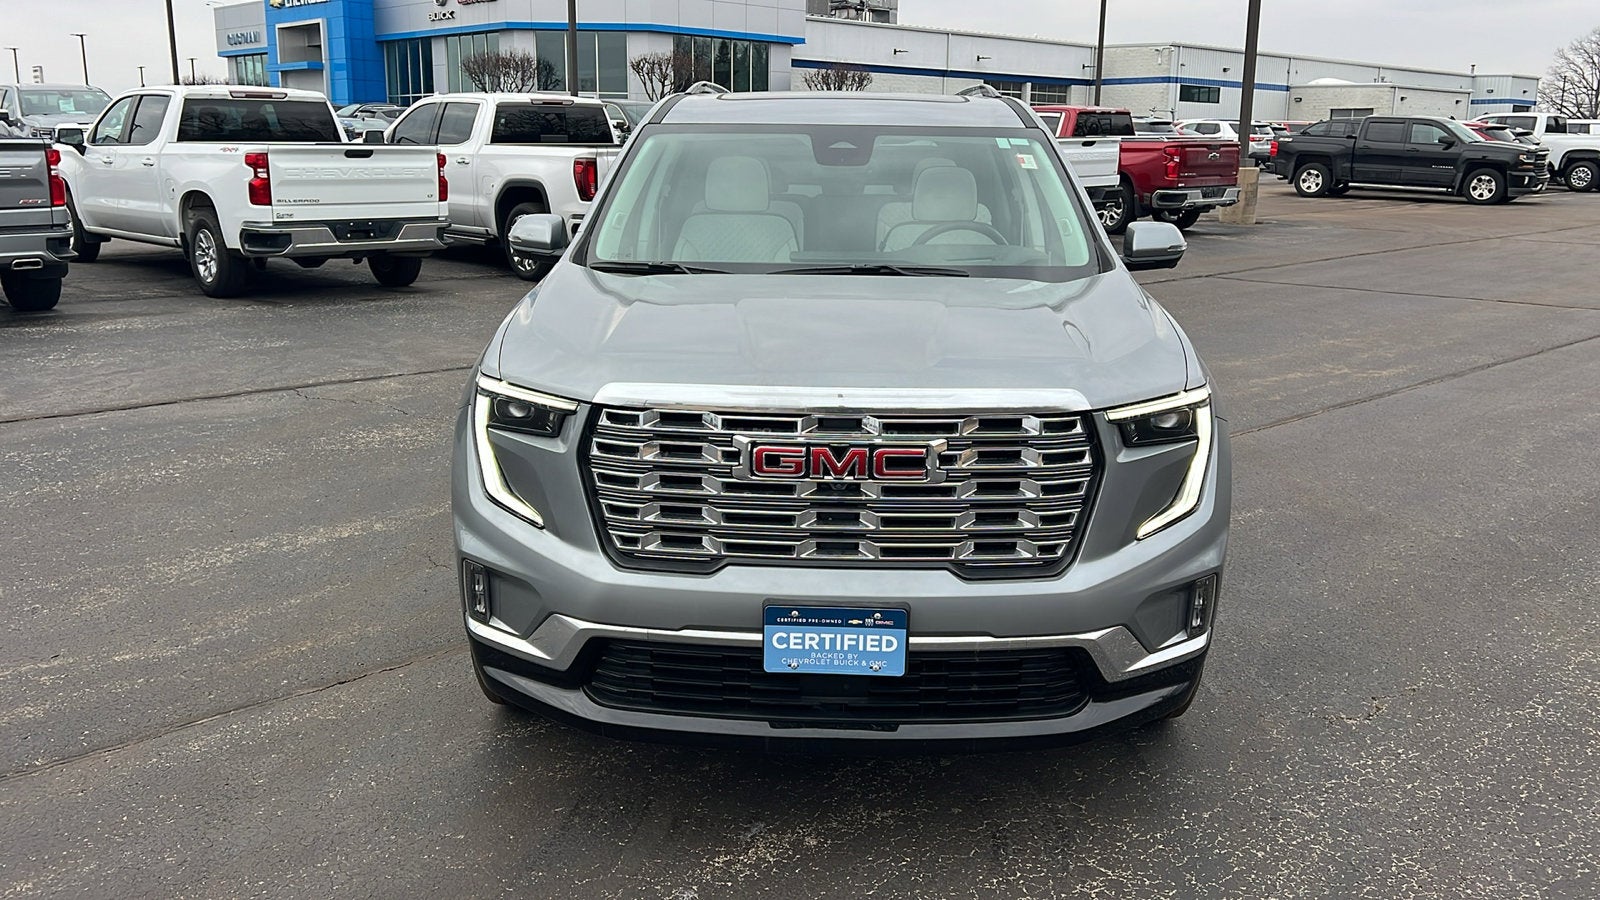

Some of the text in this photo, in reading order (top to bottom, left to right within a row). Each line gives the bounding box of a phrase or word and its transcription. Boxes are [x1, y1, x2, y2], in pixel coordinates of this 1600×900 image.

[428, 10, 455, 21] BUICK
[284, 167, 429, 179] CHEVROLET
[753, 446, 927, 479] GMC
[772, 632, 898, 652] CERTIFIED
[781, 657, 888, 668] CHEVROLET BUICK & GMC
